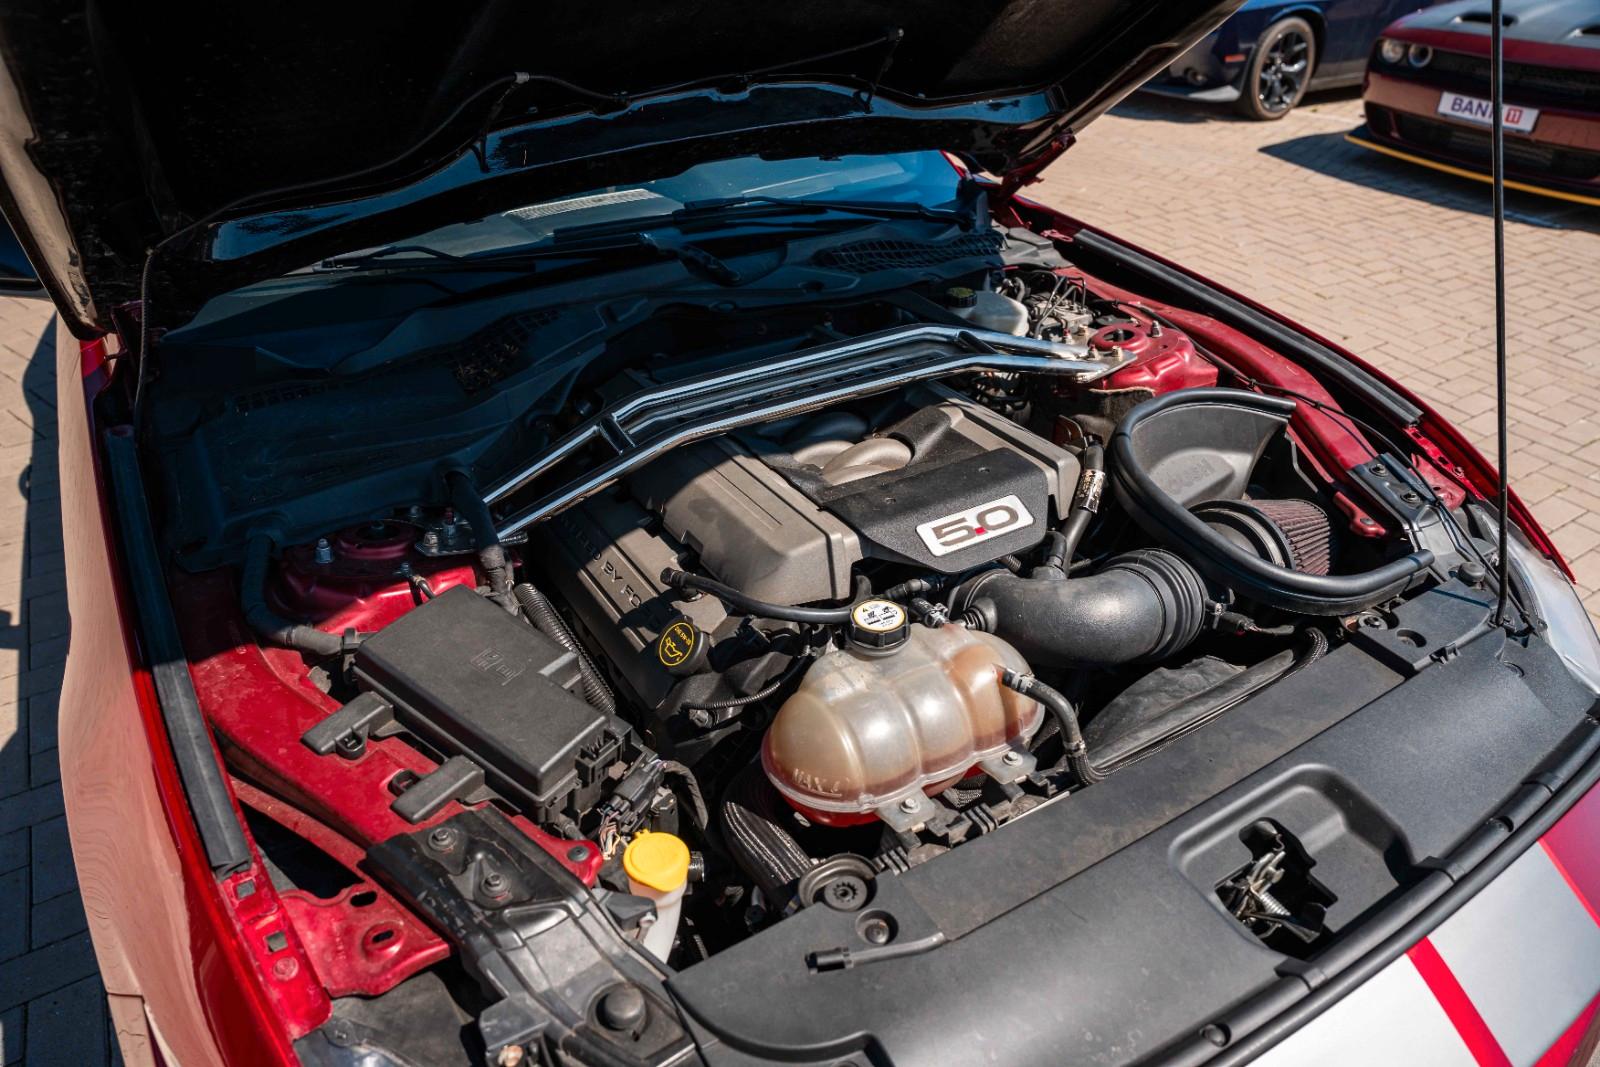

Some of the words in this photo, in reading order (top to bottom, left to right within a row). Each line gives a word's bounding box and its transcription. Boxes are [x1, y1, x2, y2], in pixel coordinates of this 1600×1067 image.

[1451, 97, 1493, 119] BAN
[932, 505, 1018, 547] 5.0
[601, 561, 623, 583] BY
